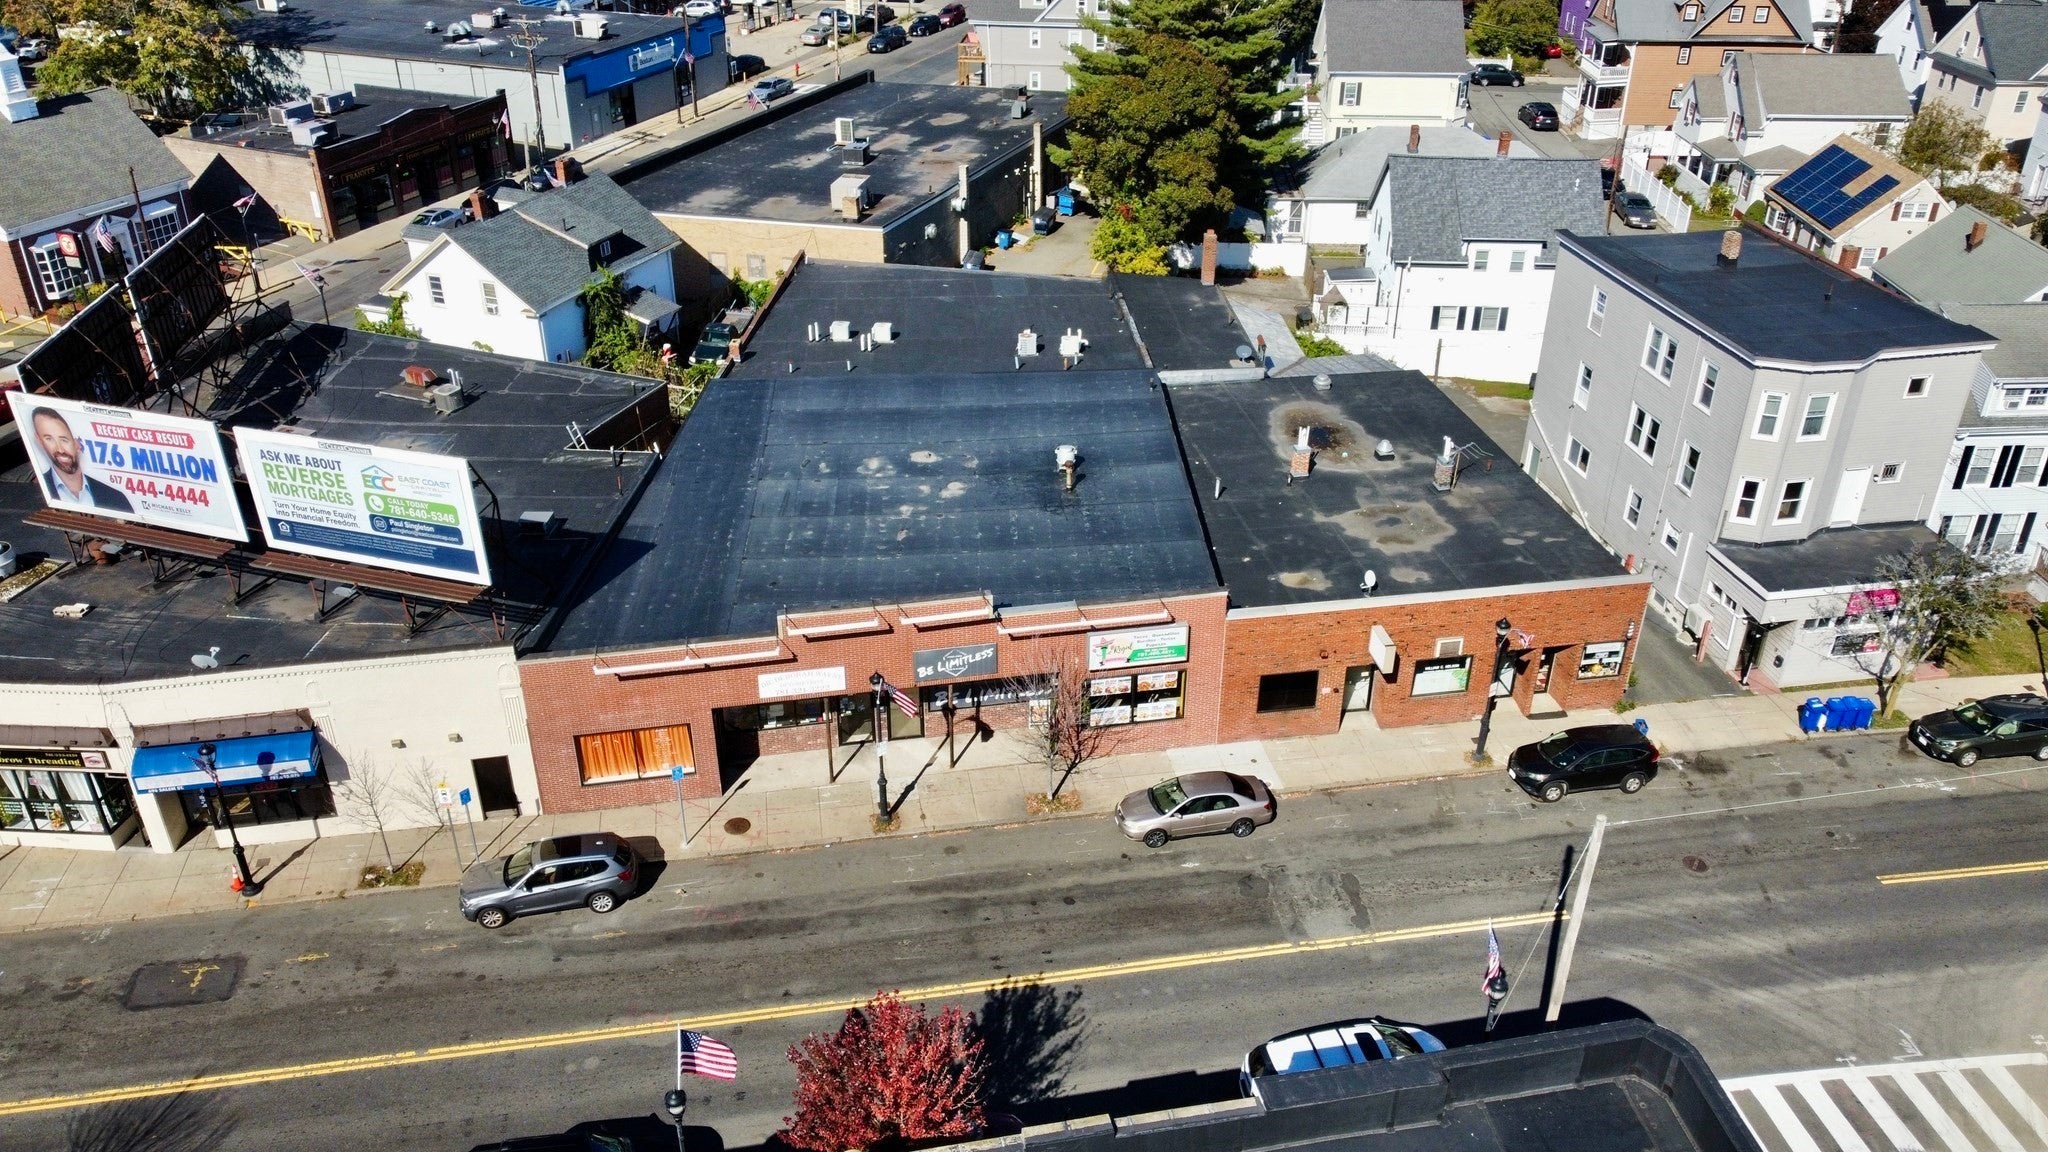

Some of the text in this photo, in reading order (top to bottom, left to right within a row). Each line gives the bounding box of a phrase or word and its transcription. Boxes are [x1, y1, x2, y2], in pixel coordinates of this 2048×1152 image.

[95, 424, 189, 447] RECENT CASE RESULT
[130, 446, 219, 483] MILLION
[260, 449, 342, 471] ASK ME ABOUT
[262, 462, 347, 490] REVERSE
[361, 473, 397, 492] ECC
[398, 475, 451, 489] EAST COAST
[110, 474, 209, 507] 617 444-4444
[267, 480, 354, 506] MORTGAGES
[151, 503, 174, 511] MICHAEL
[272, 500, 357, 521] Turn Your Home Equity
[387, 497, 429, 509] CALL TODAY
[275, 508, 361, 528] Into Financial Freedom.
[389, 519, 435, 533] Paul Singleton
[917, 648, 994, 678] BE LIMITLESS
[25, 757, 81, 767] Threading
